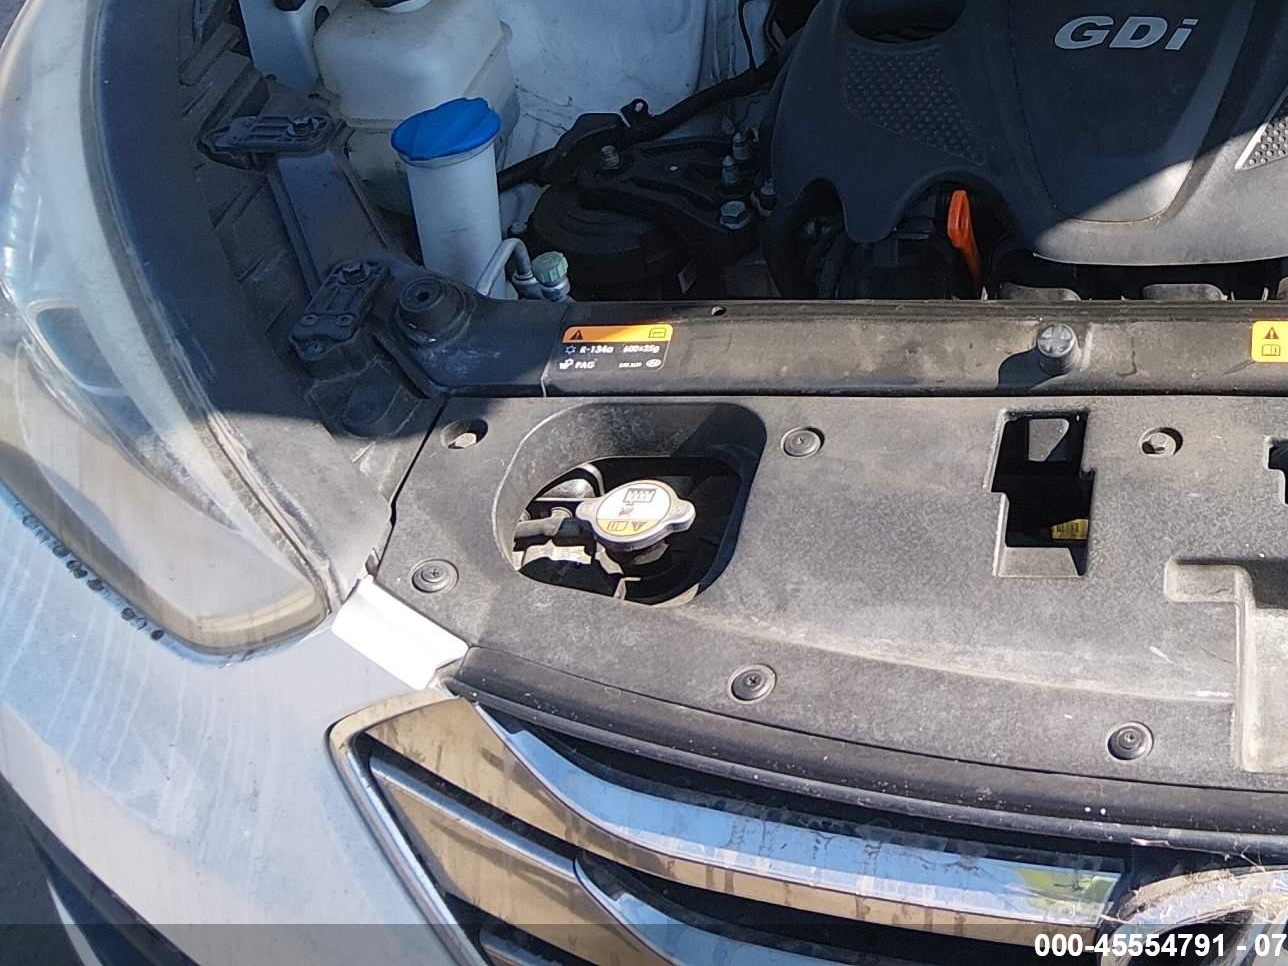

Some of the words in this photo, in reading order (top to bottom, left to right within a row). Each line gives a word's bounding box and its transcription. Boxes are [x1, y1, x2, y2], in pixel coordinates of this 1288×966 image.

[1054, 15, 1199, 51] GDi
[579, 344, 615, 354] R-134a
[574, 360, 597, 369] PAG
